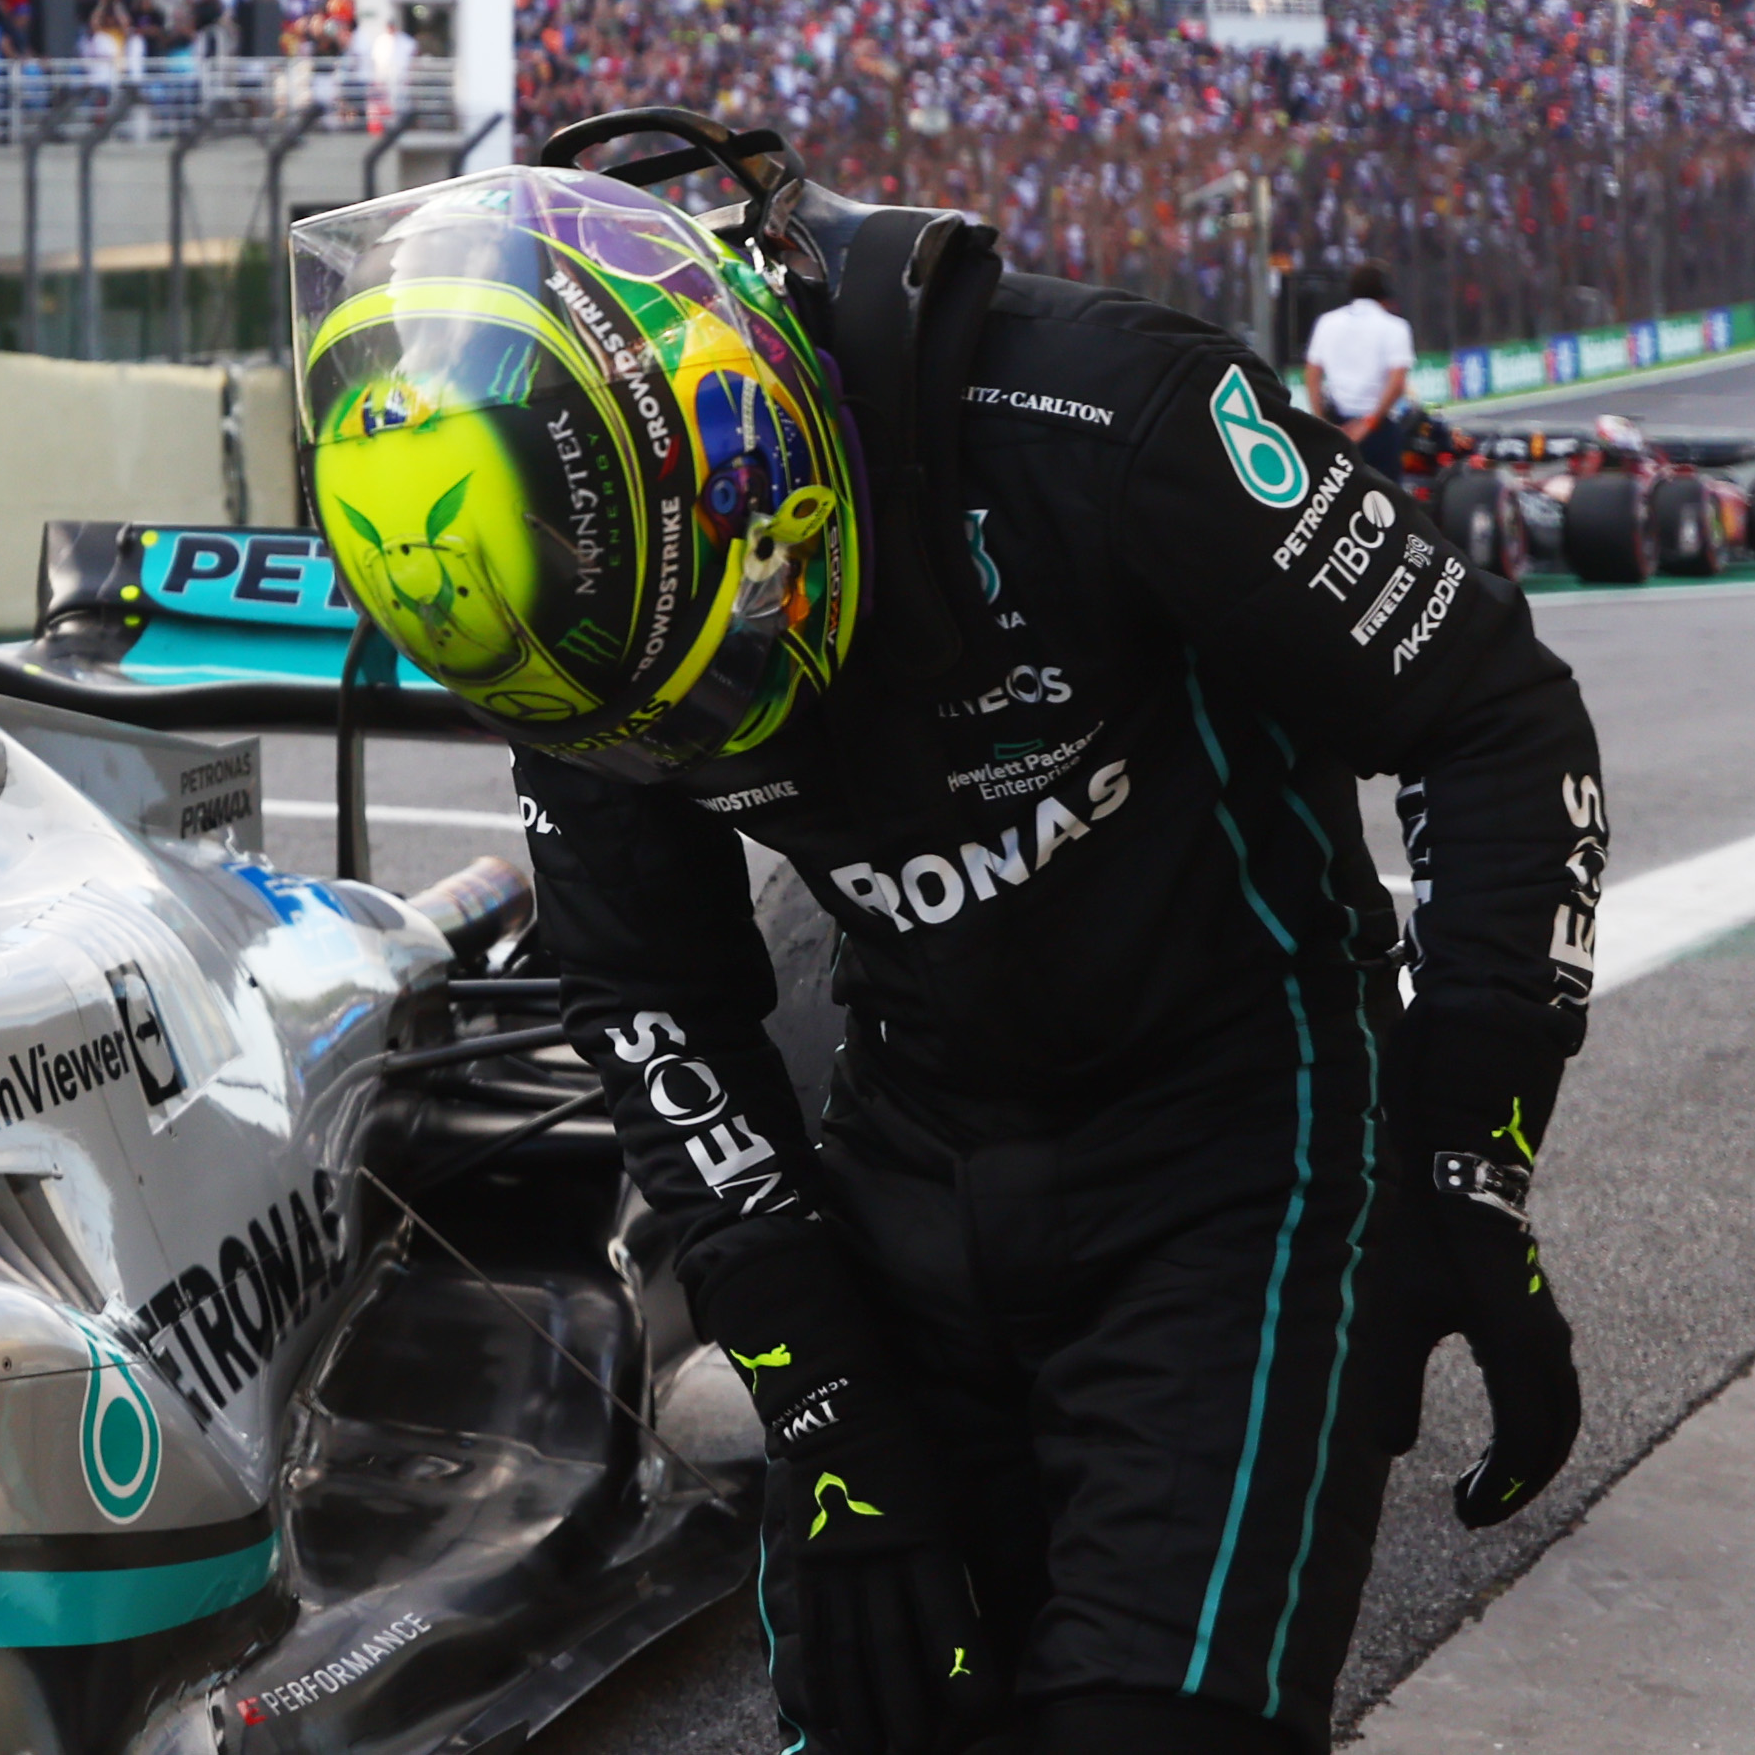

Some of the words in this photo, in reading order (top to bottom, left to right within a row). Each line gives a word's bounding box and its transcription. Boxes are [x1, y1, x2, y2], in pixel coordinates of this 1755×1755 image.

[962, 386, 1115, 426] ITZ-CARLTON
[1273, 452, 1355, 571] PETRONAS
[632, 495, 681, 682] ROWDSTRIKE
[1351, 565, 1417, 646] PIRELLI
[180, 753, 252, 795] PETRONAS
[947, 763, 1025, 793] Hewlett
[830, 758, 1131, 933] RONAS
[261, 1611, 432, 1717] PERFORMANCE
